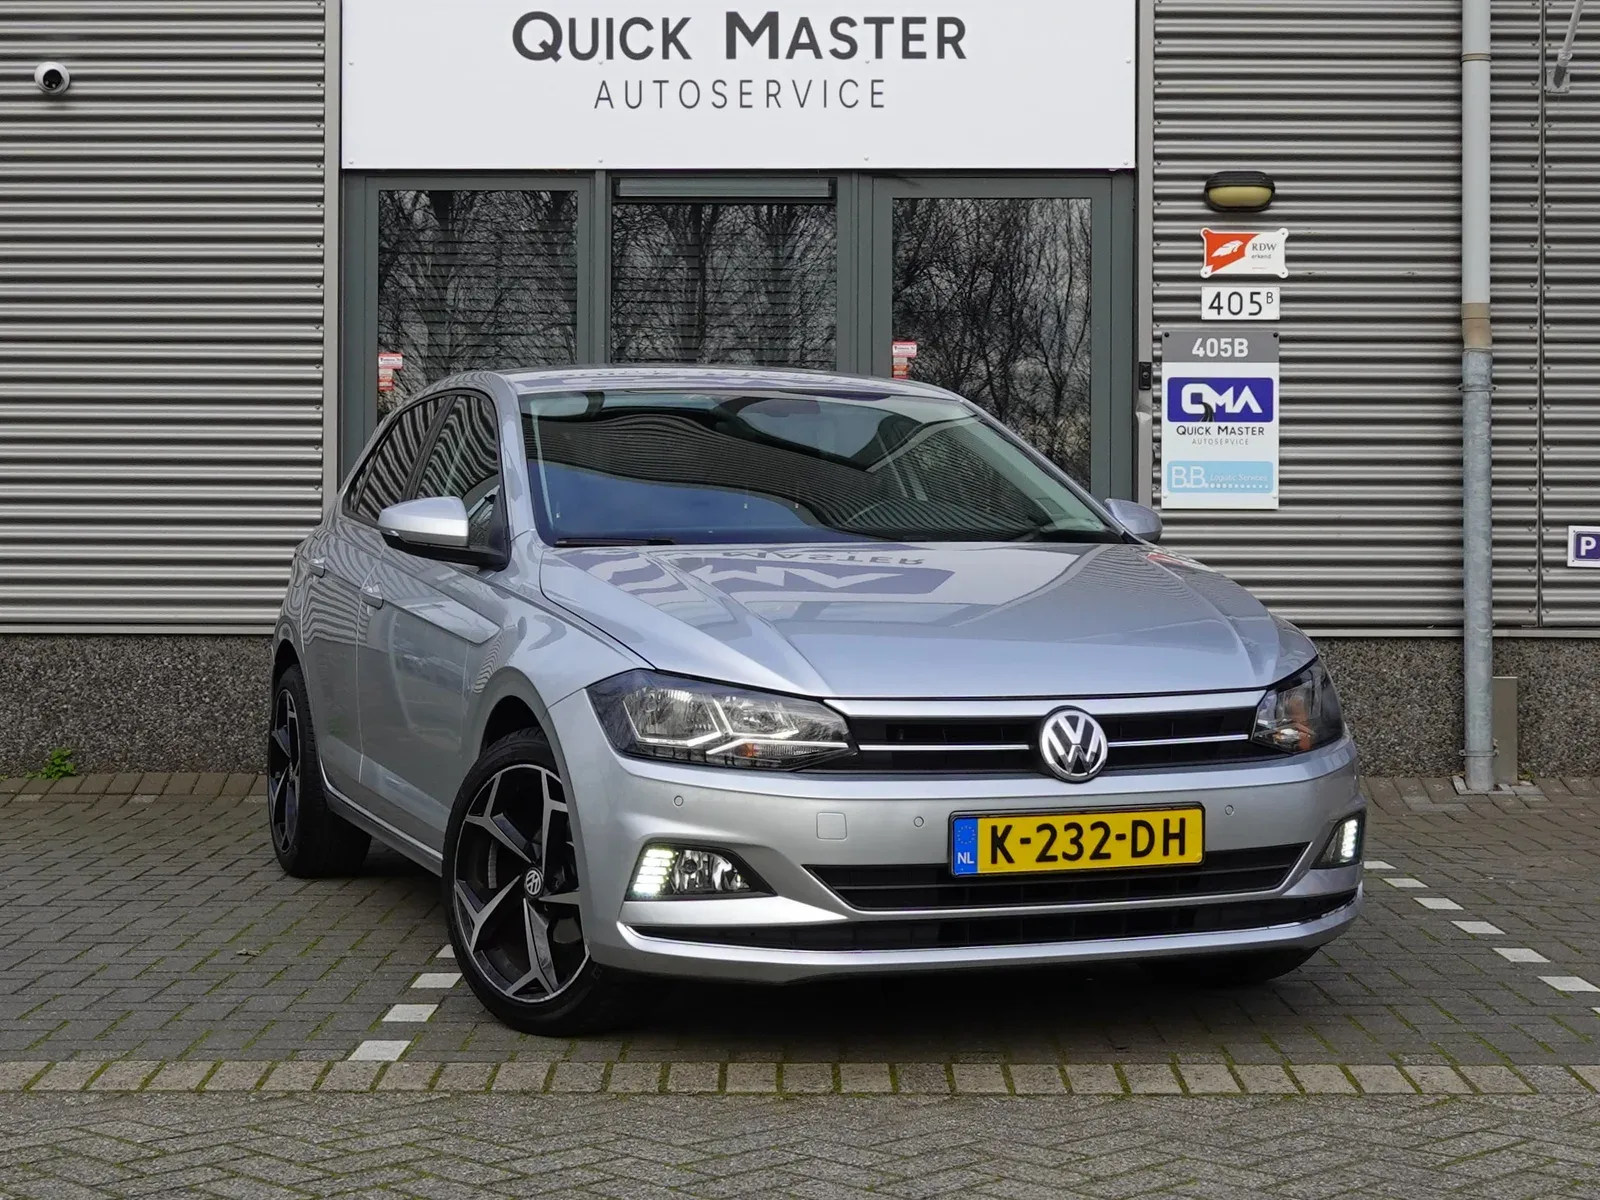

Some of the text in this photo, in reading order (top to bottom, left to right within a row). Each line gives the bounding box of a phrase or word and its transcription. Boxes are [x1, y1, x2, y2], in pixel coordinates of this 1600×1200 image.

[512, 11, 967, 62] QUICK MASTER
[594, 79, 885, 109] AUTOSERVICE
[1251, 242, 1277, 251] RDW
[1192, 338, 1249, 357] 405B
[1176, 425, 1265, 436] QUICK MASTER
[1192, 438, 1249, 446] AUTOSERVICE
[1580, 536, 1597, 556] P
[990, 817, 1186, 864] K-232-DH
[957, 851, 975, 865] NL
